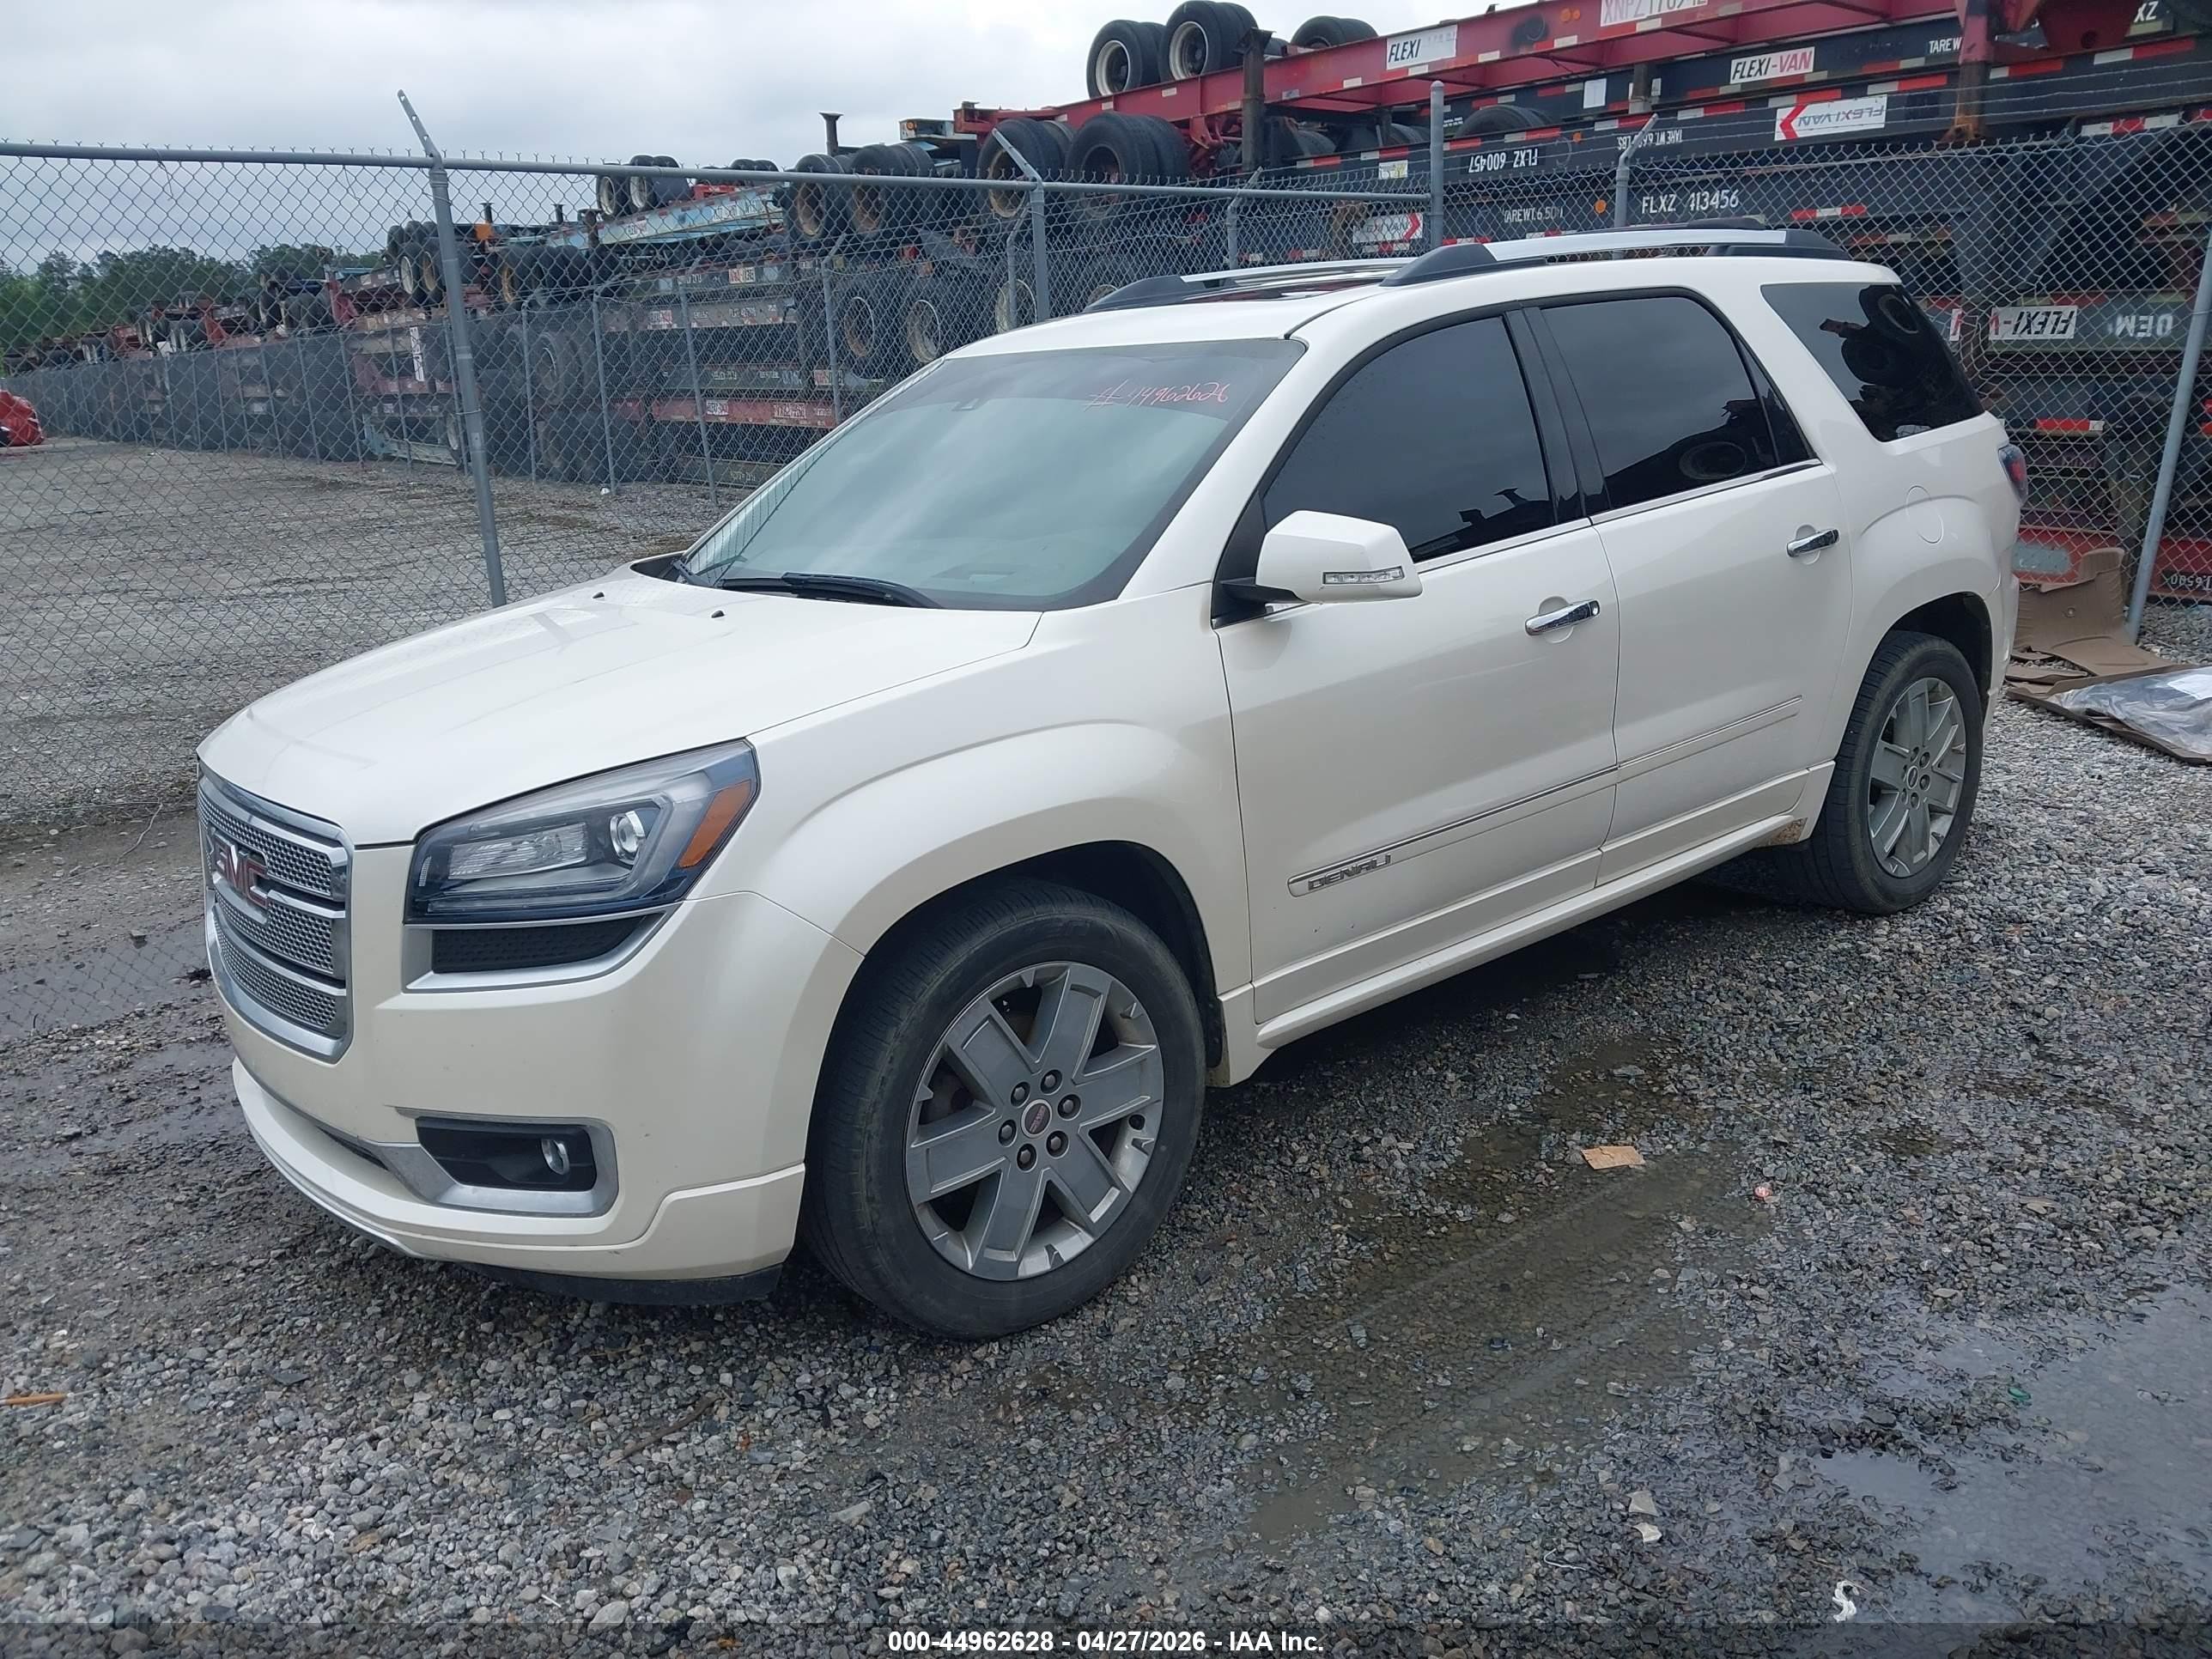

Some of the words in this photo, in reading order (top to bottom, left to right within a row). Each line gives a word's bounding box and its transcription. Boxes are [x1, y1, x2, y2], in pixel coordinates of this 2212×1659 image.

[1388, 39, 1421, 63] FLEXI
[1732, 51, 1813, 81] FLEXI-VAN
[1468, 152, 1507, 173] 600457
[1512, 148, 1538, 168] FLXZ
[1641, 193, 1677, 215] FLXZ
[1308, 853, 1391, 890] DENALI
